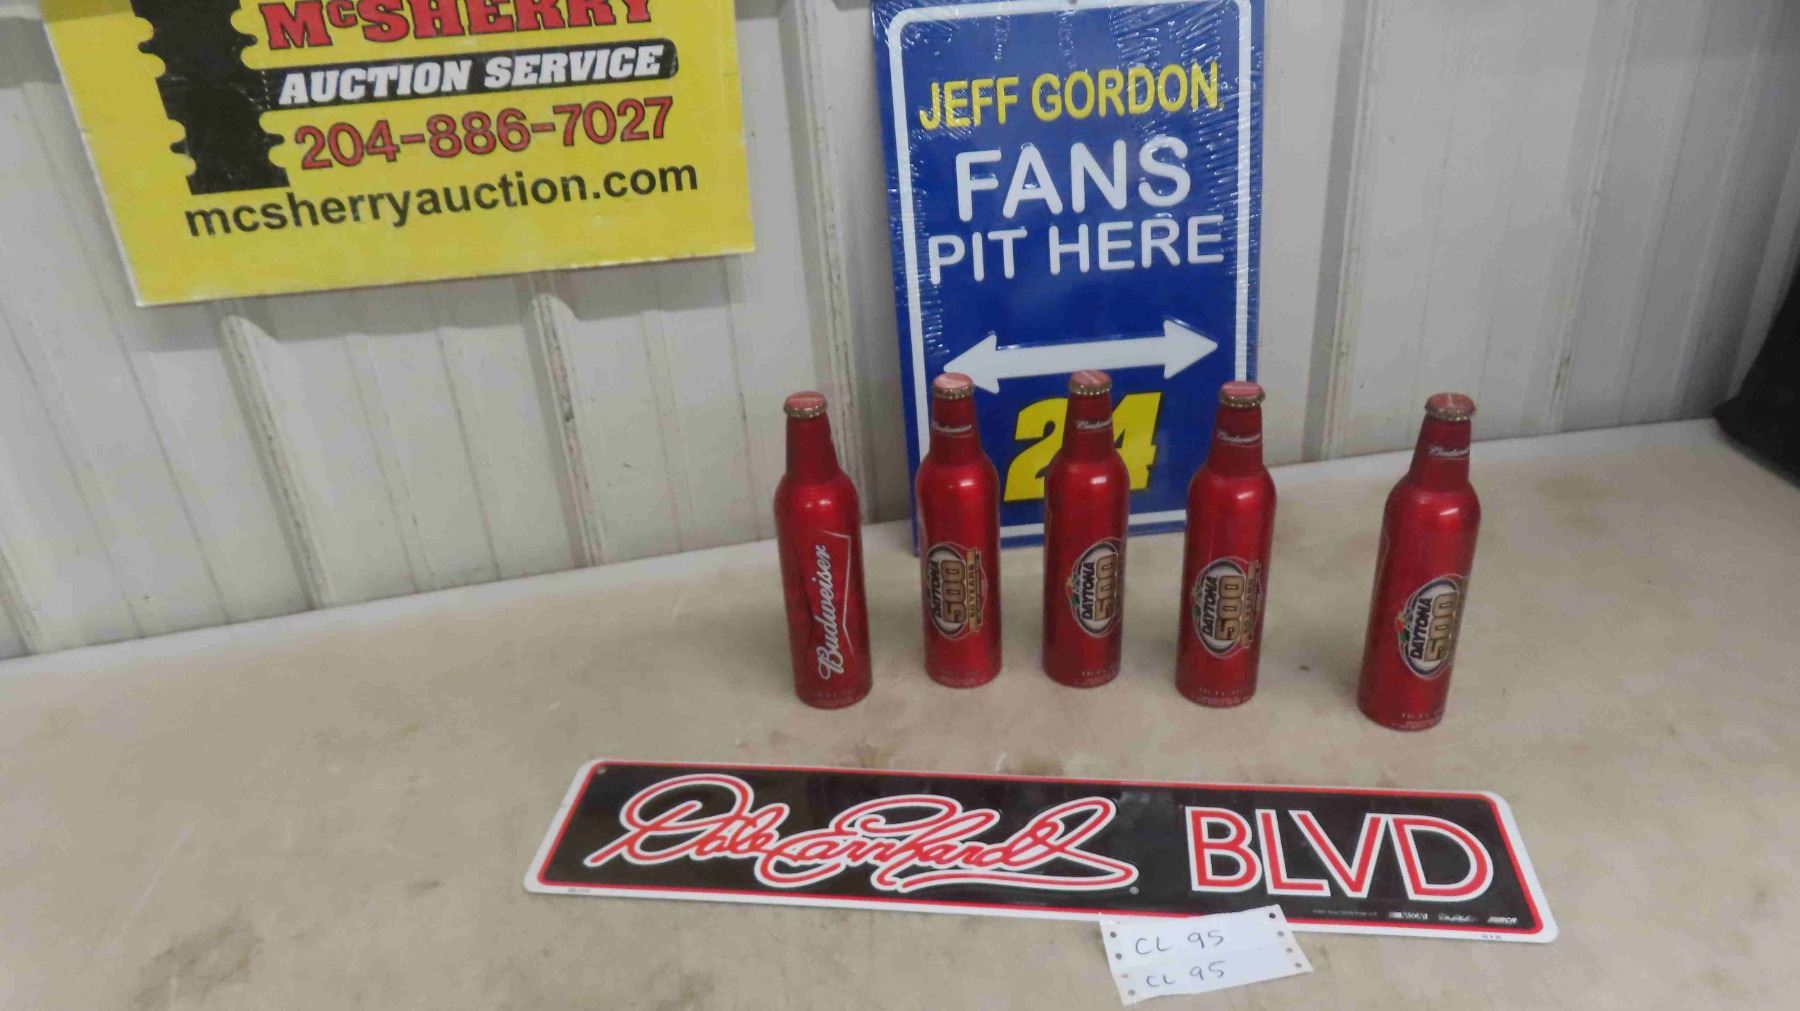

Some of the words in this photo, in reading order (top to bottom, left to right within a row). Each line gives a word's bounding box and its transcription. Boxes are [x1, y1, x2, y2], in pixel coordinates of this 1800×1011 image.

[278, 59, 473, 105] AUCTION
[484, 44, 664, 91] SERVICE
[918, 76, 1019, 130] JEFF
[1031, 61, 1221, 122] GORDON
[294, 96, 673, 170] 204-886-7027
[185, 164, 698, 237] mcsherryauction.com
[955, 135, 1192, 222] FANS
[928, 229, 1028, 285] PIT
[1049, 214, 1225, 276] HERE
[1003, 391, 1162, 502] 24
[812, 543, 844, 680] Budweiser
[940, 560, 967, 623] 500
[1080, 561, 1096, 620] DAYTONA
[1093, 554, 1118, 621] 500
[1202, 576, 1218, 637] DAYTONA
[1214, 575, 1246, 640] 500
[1409, 597, 1433, 660] DAYTONA
[1423, 592, 1459, 662] 500
[584, 773, 790, 867] Dale
[1185, 806, 1494, 902] BLVD
[1135, 937, 1170, 955] CL
[1187, 930, 1224, 949] 95
[1146, 973, 1176, 988] CL
[1189, 961, 1226, 981] 95
